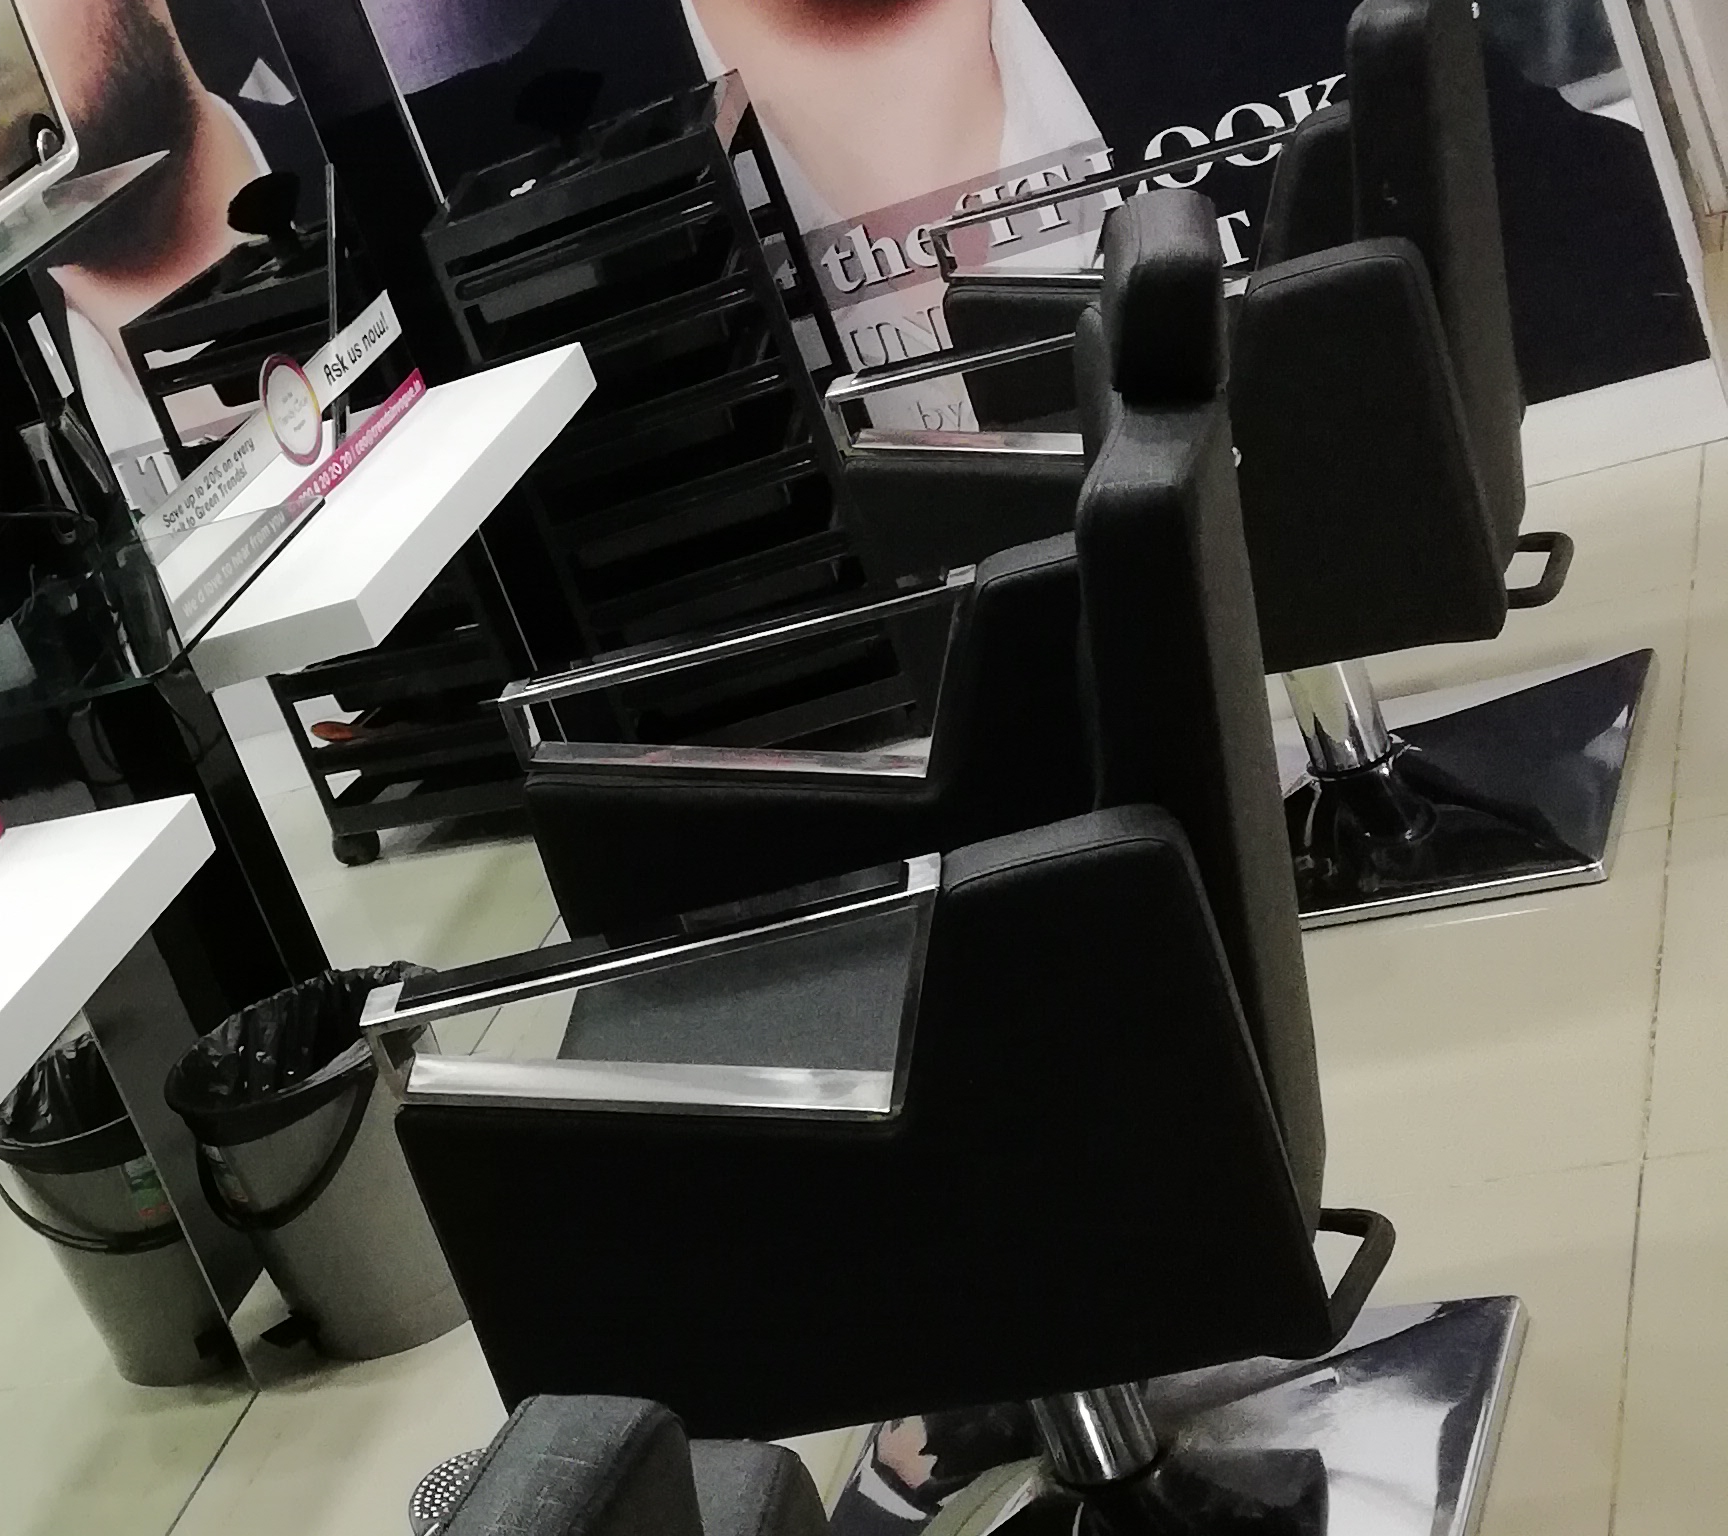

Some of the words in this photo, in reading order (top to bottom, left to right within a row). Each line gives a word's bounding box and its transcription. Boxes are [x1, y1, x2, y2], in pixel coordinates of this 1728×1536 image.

[821, 222, 956, 294] the
[323, 353, 349, 386] Ask
[347, 342, 363, 365] us
[362, 311, 391, 353] now!
